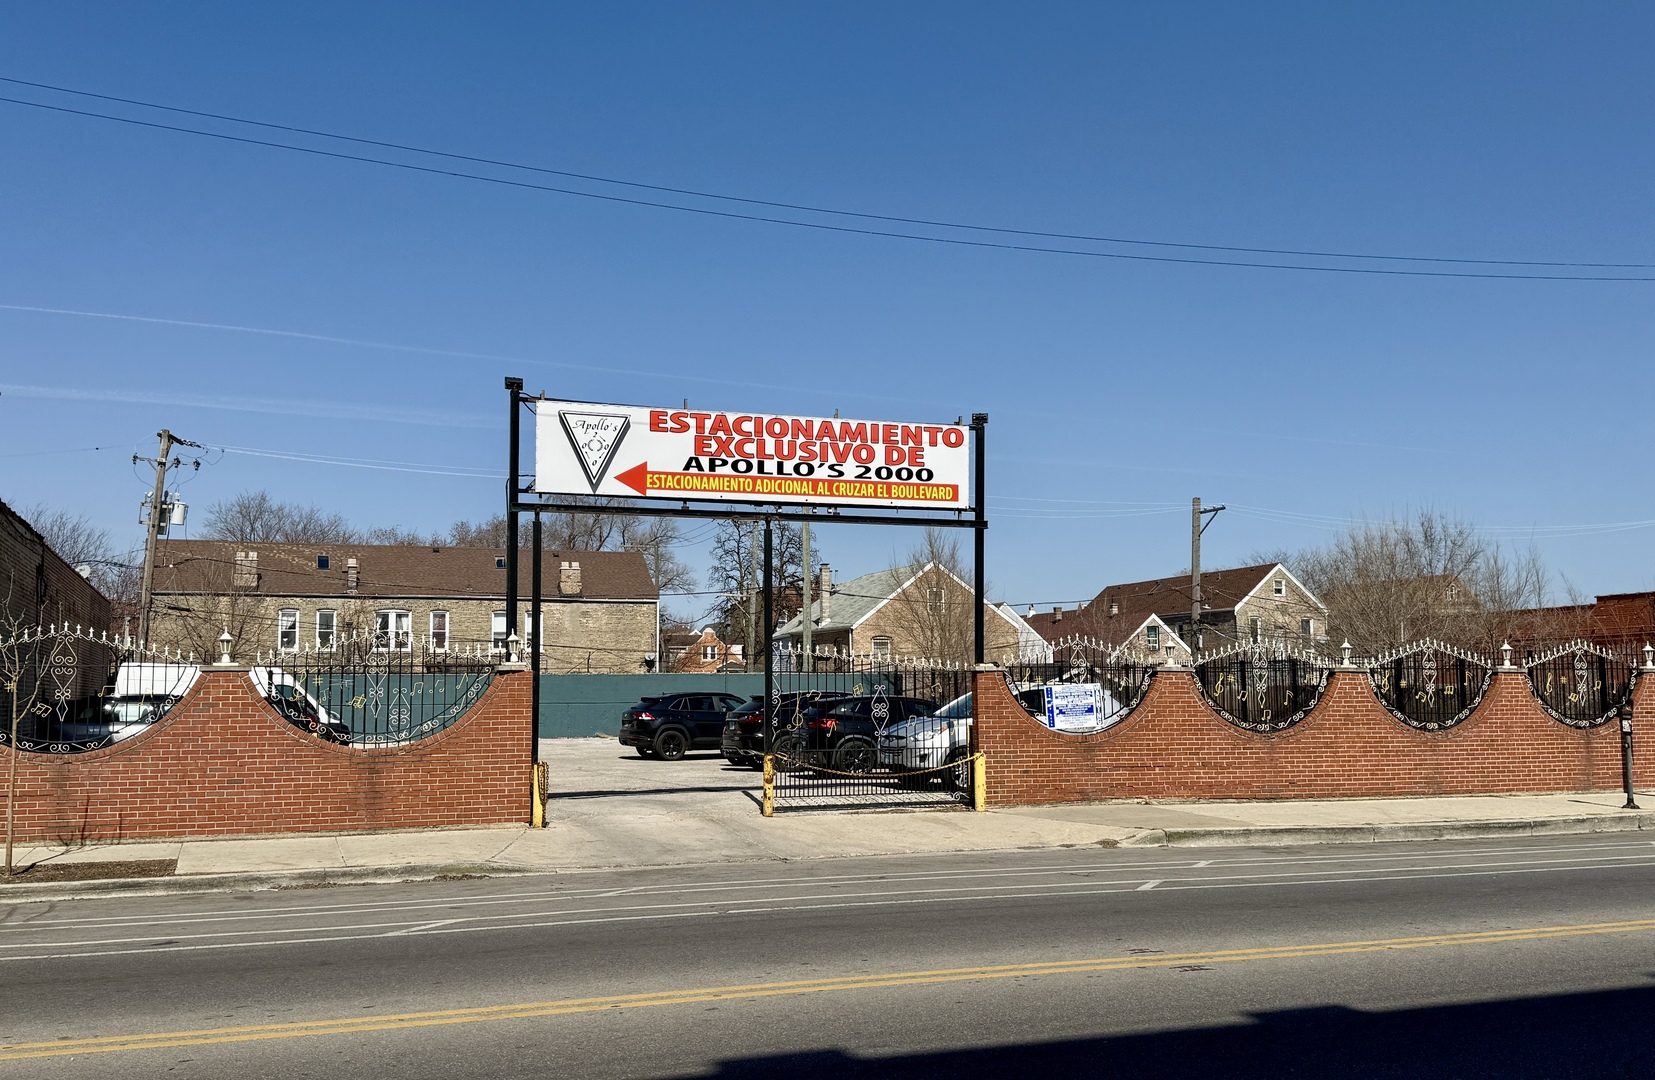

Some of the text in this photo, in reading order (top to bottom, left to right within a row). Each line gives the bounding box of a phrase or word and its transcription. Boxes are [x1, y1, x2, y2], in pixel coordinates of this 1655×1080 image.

[572, 417, 619, 434] Apollo's
[650, 410, 964, 448] ESTACIONAMIENTO
[694, 434, 925, 467] EXCLUSIVO DE
[682, 456, 934, 482] APOLLO'S 2000
[646, 474, 953, 500] ESTACIONAMIENTO ADICIONAL AL CRUZAR EL BOULEVARD
